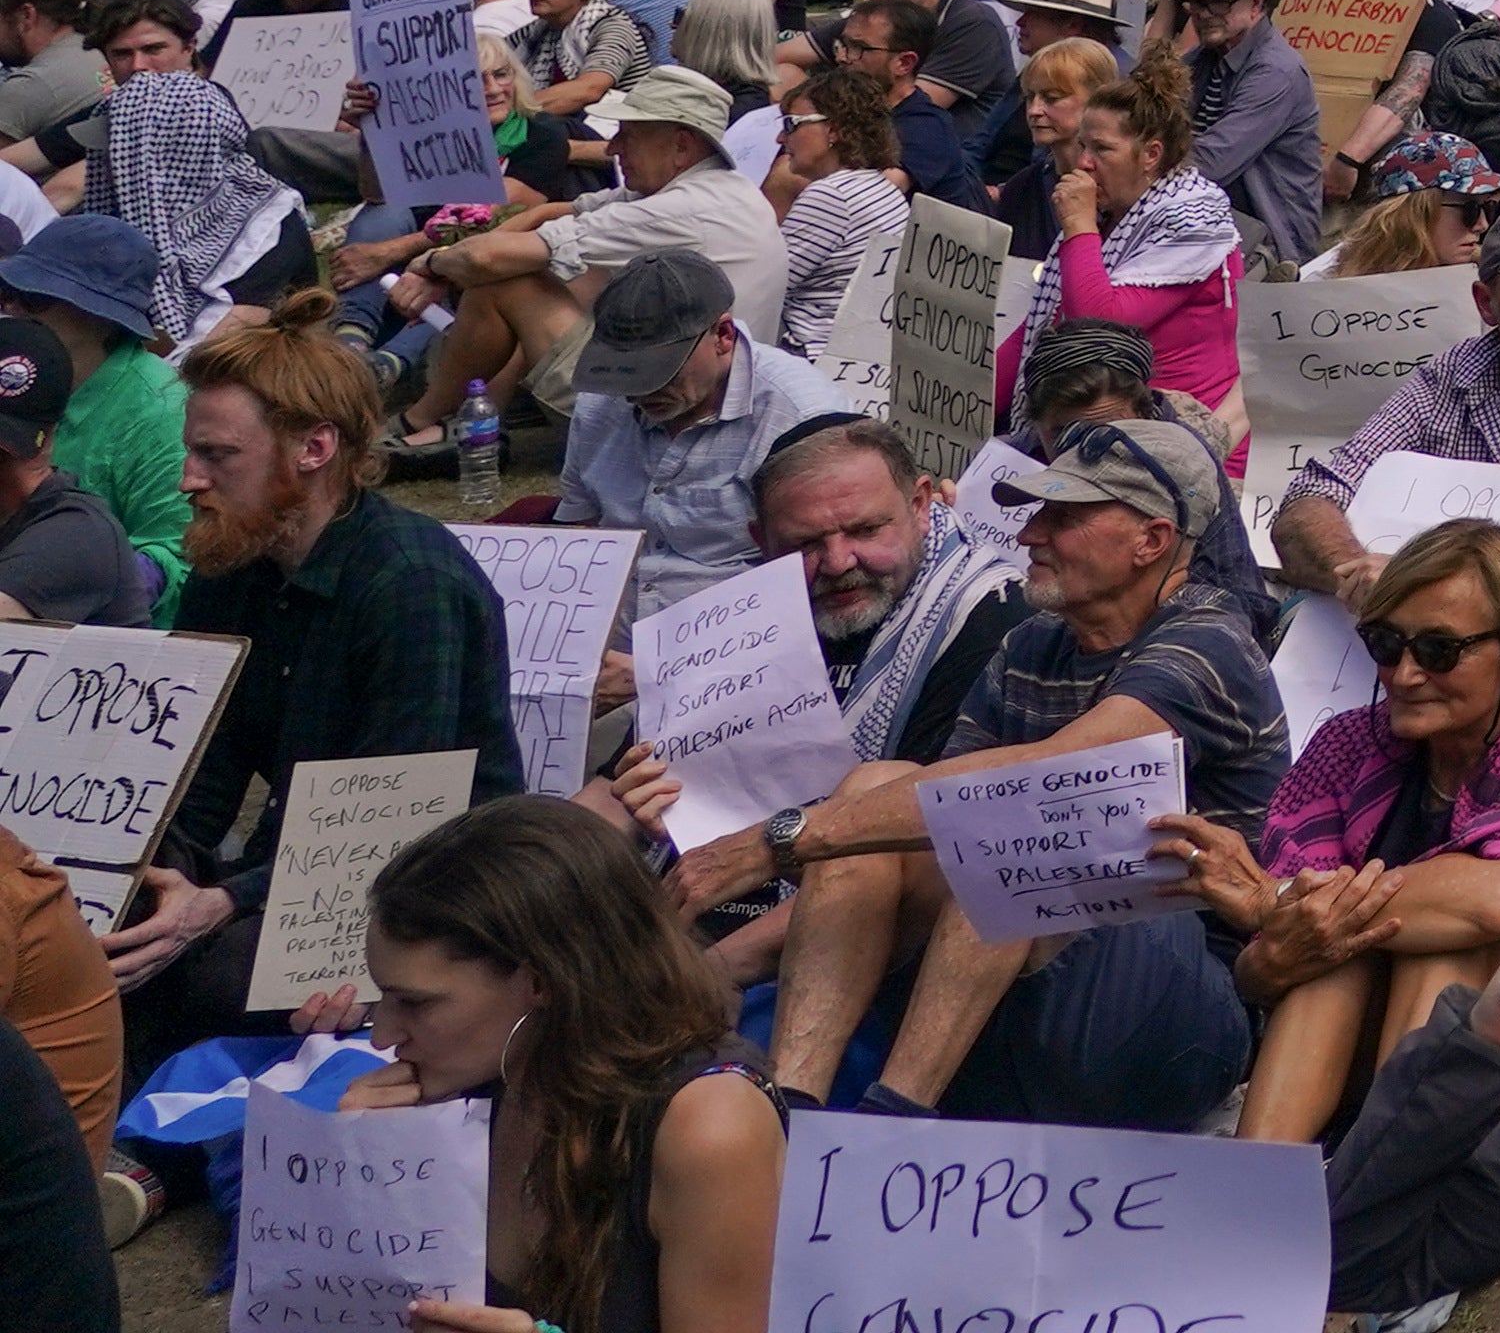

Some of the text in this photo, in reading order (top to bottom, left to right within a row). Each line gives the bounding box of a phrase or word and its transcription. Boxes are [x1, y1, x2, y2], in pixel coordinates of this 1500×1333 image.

[376, 3, 473, 67] SUPPORT
[1283, 26, 1396, 53] GENOCIDE
[363, 67, 480, 130] PALESTINE
[400, 128, 490, 183] ACTION
[922, 235, 1002, 300] OPPOSE
[894, 292, 996, 371] GENOCIDE
[1310, 305, 1440, 337] OPPOSE
[909, 379, 993, 447] SUPPORT
[675, 593, 762, 644] OPPOSE
[657, 624, 780, 686] GENOCIDE
[36, 661, 198, 750] OPPOSE
[675, 665, 770, 717] SUPPORT
[653, 691, 829, 762] PALESTINE ACTION
[330, 771, 408, 796] OPPOSE
[958, 762, 1171, 802] OPPOSE GENOCIDE
[308, 796, 446, 834] GENOCIDE
[978, 829, 1092, 857] SUPPORT
[348, 869, 364, 882] IS
[996, 858, 1146, 888] PALESTINE
[1035, 897, 1134, 919] ACTION
[285, 963, 367, 983] TERRORIS
[288, 1150, 435, 1189] OPPOSE
[808, 1148, 1178, 1243] I OPPOSE
[248, 1220, 447, 1256] GENOCIDE
[283, 1269, 458, 1305] SUPPORT
